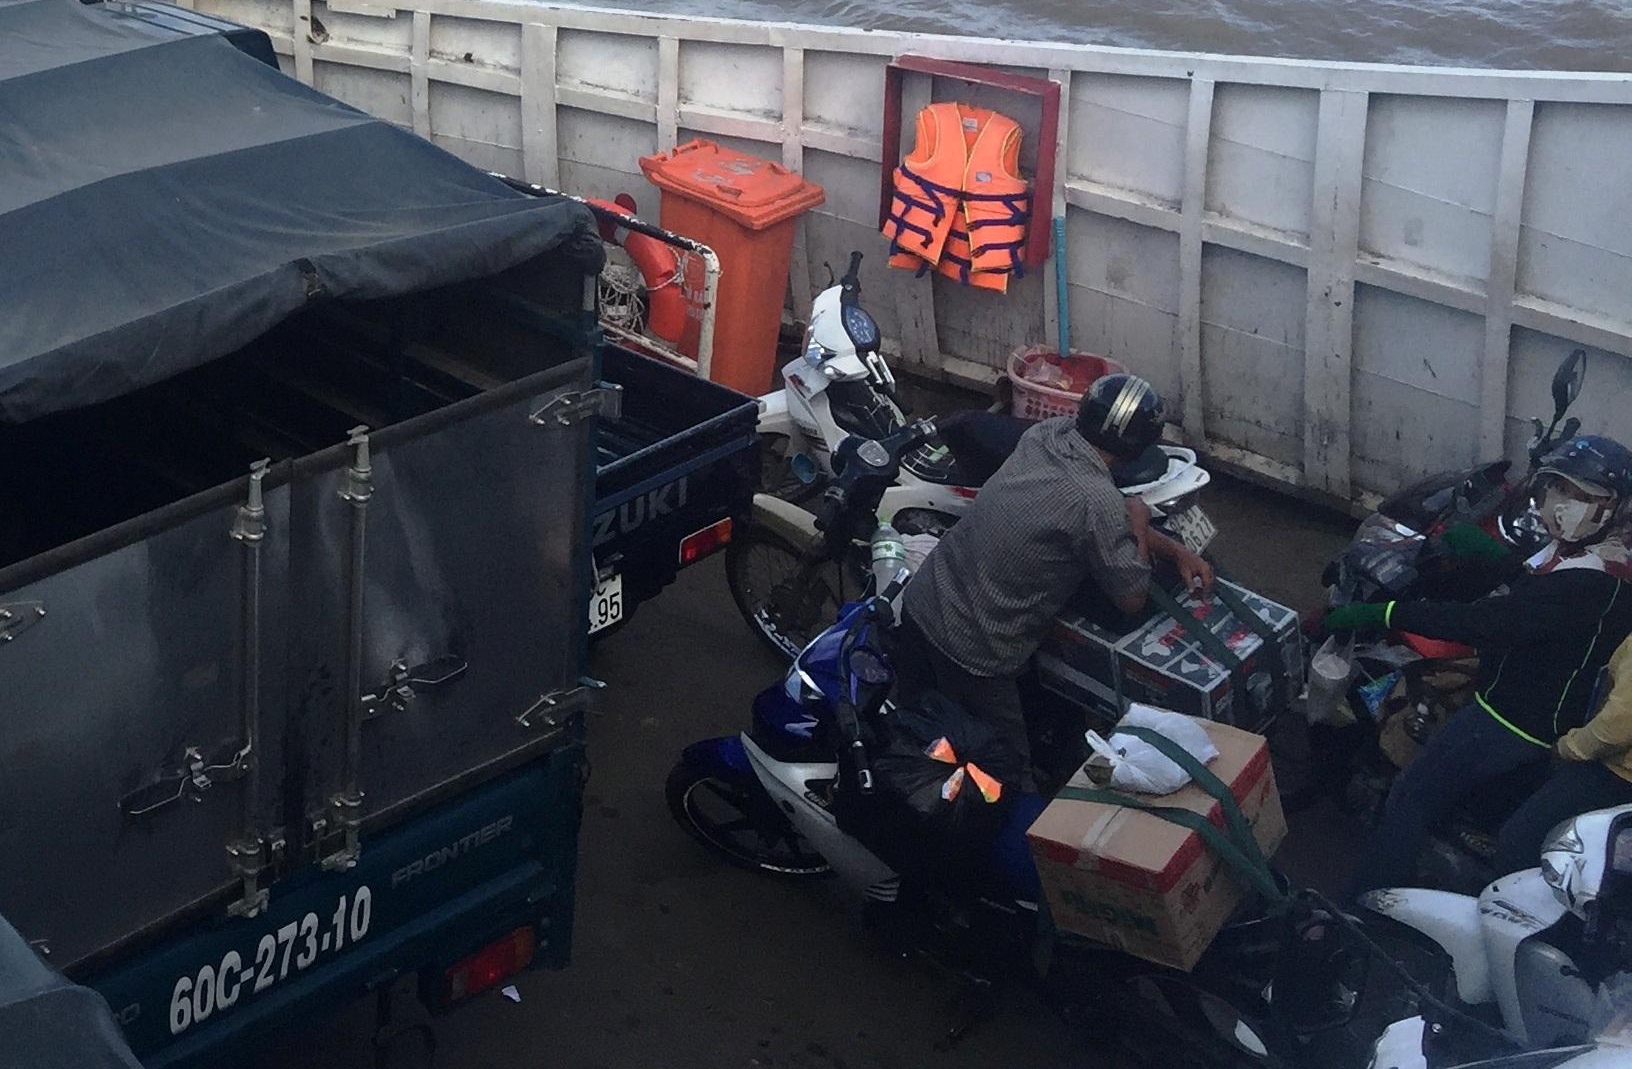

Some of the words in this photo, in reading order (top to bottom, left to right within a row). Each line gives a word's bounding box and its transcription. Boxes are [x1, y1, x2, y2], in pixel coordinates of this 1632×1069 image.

[593, 477, 688, 546] ZUKI
[391, 815, 514, 889] FRONTIER
[169, 885, 372, 1034] 60C-273.10
